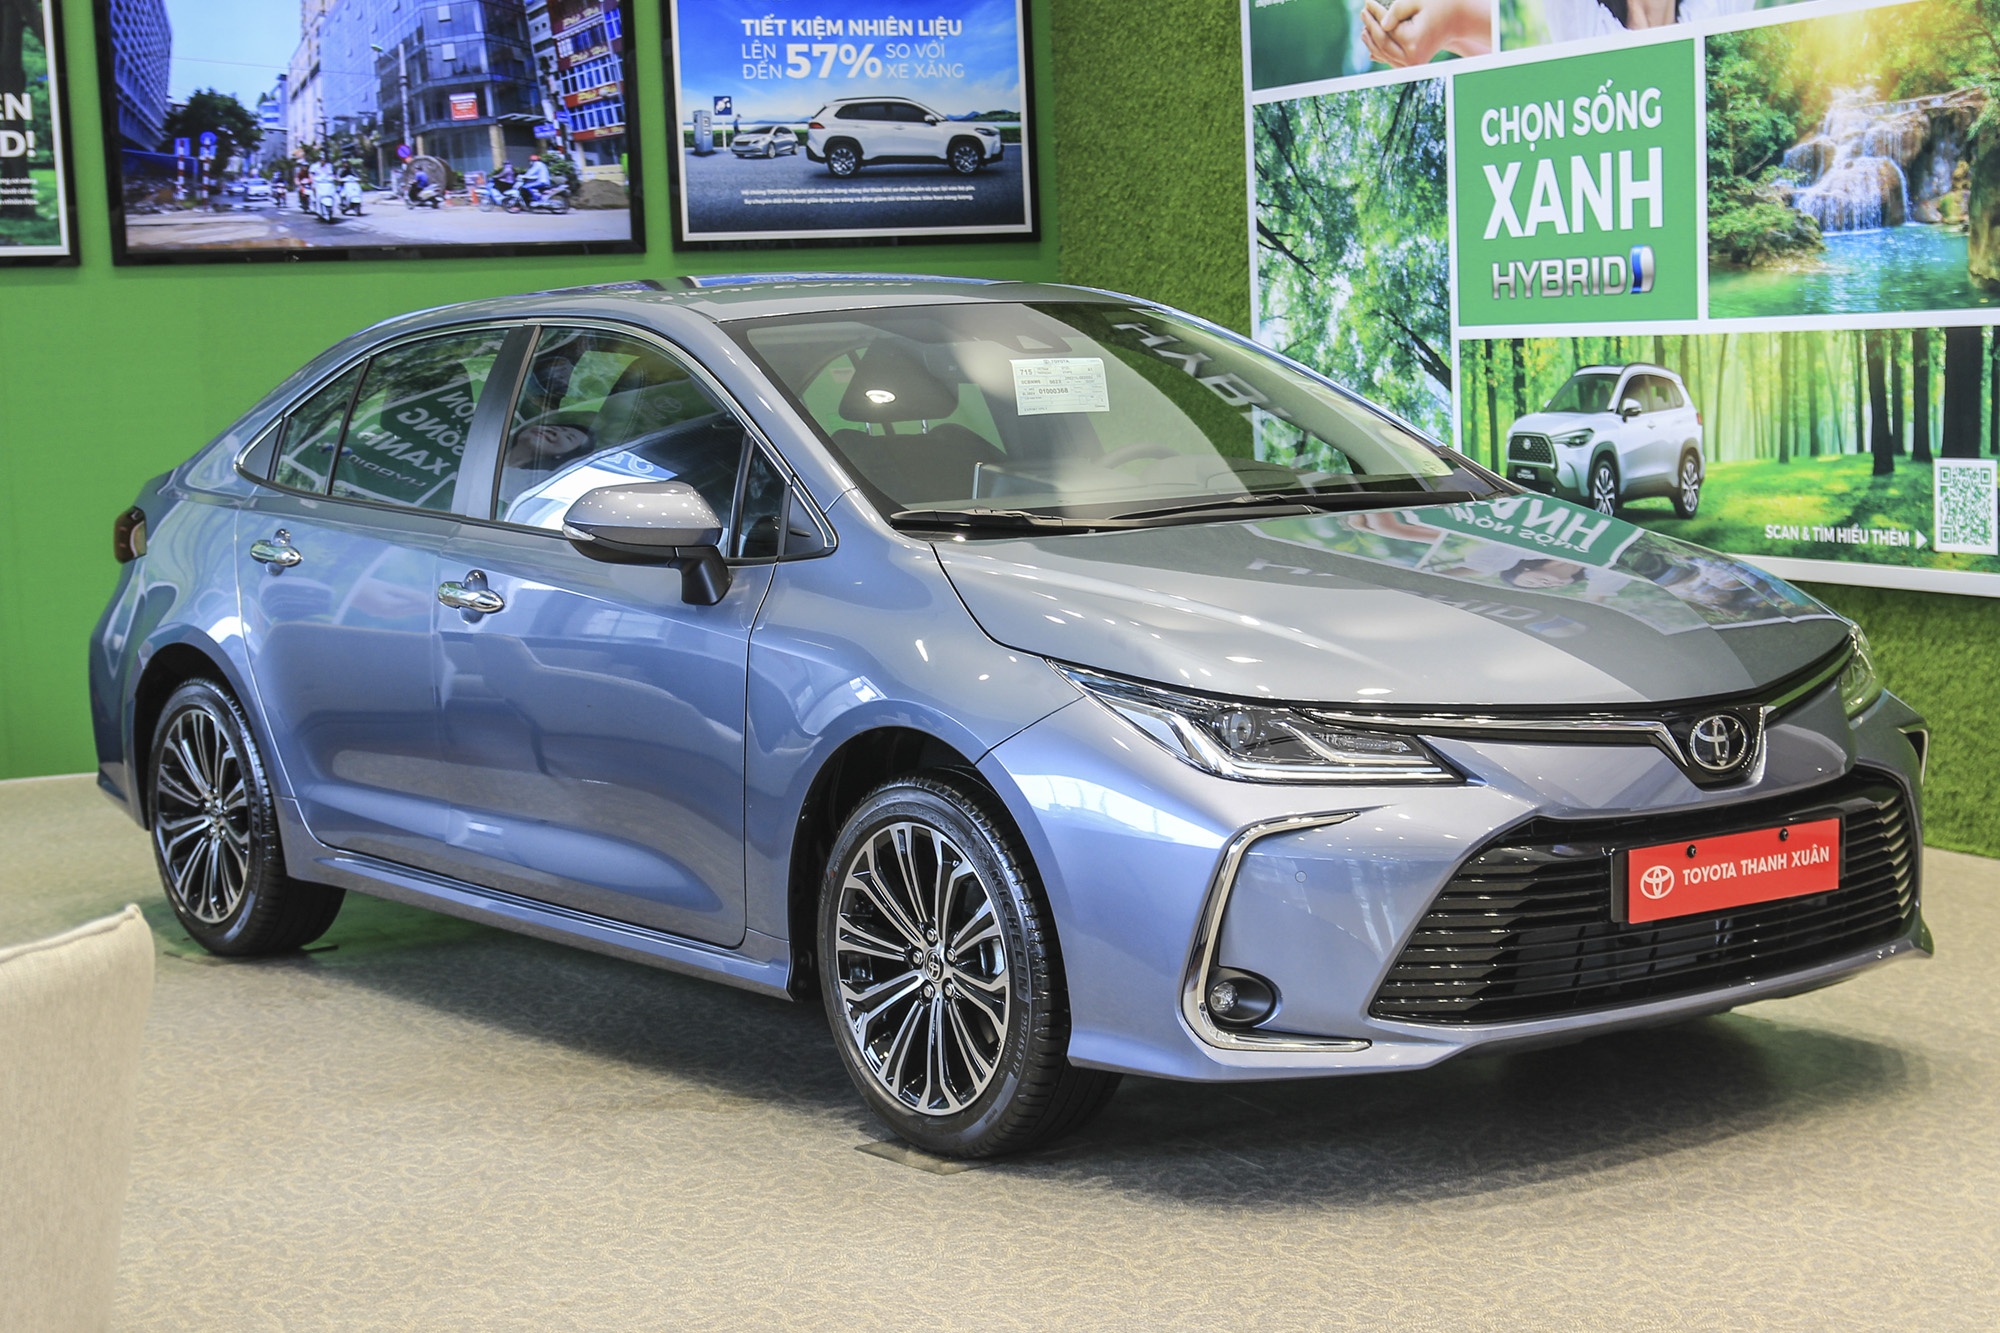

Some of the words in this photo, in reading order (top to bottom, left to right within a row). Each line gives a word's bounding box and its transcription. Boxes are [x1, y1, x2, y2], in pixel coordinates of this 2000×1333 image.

[741, 13, 787, 37] TIẾT
[791, 16, 845, 40] KIỆM
[848, 15, 913, 37] NHIÊN
[918, 15, 963, 40] LIỆU
[741, 39, 777, 60] LÊN
[786, 43, 883, 79] 57%
[885, 43, 911, 60] SO
[914, 39, 946, 60] VỚI
[742, 59, 783, 80] ĐẾN
[886, 63, 910, 79] XE
[913, 62, 966, 79] XĂNG
[0, 92, 33, 121] N
[1480, 99, 1565, 151] CHỌN
[1572, 78, 1662, 137] SỐNG
[1482, 146, 1663, 240] XANH
[1492, 255, 1627, 300] HYBRID
[1764, 524, 1800, 541] SCAN
[1802, 526, 1811, 541] &
[1812, 524, 1836, 543] TÌM
[1871, 527, 1910, 547] THÊM
[1683, 862, 1737, 885] TOYOTA
[1741, 852, 1787, 876] THANH
[1791, 844, 1830, 868] XUÂN
[989, 869, 1029, 994] MICHELIN
